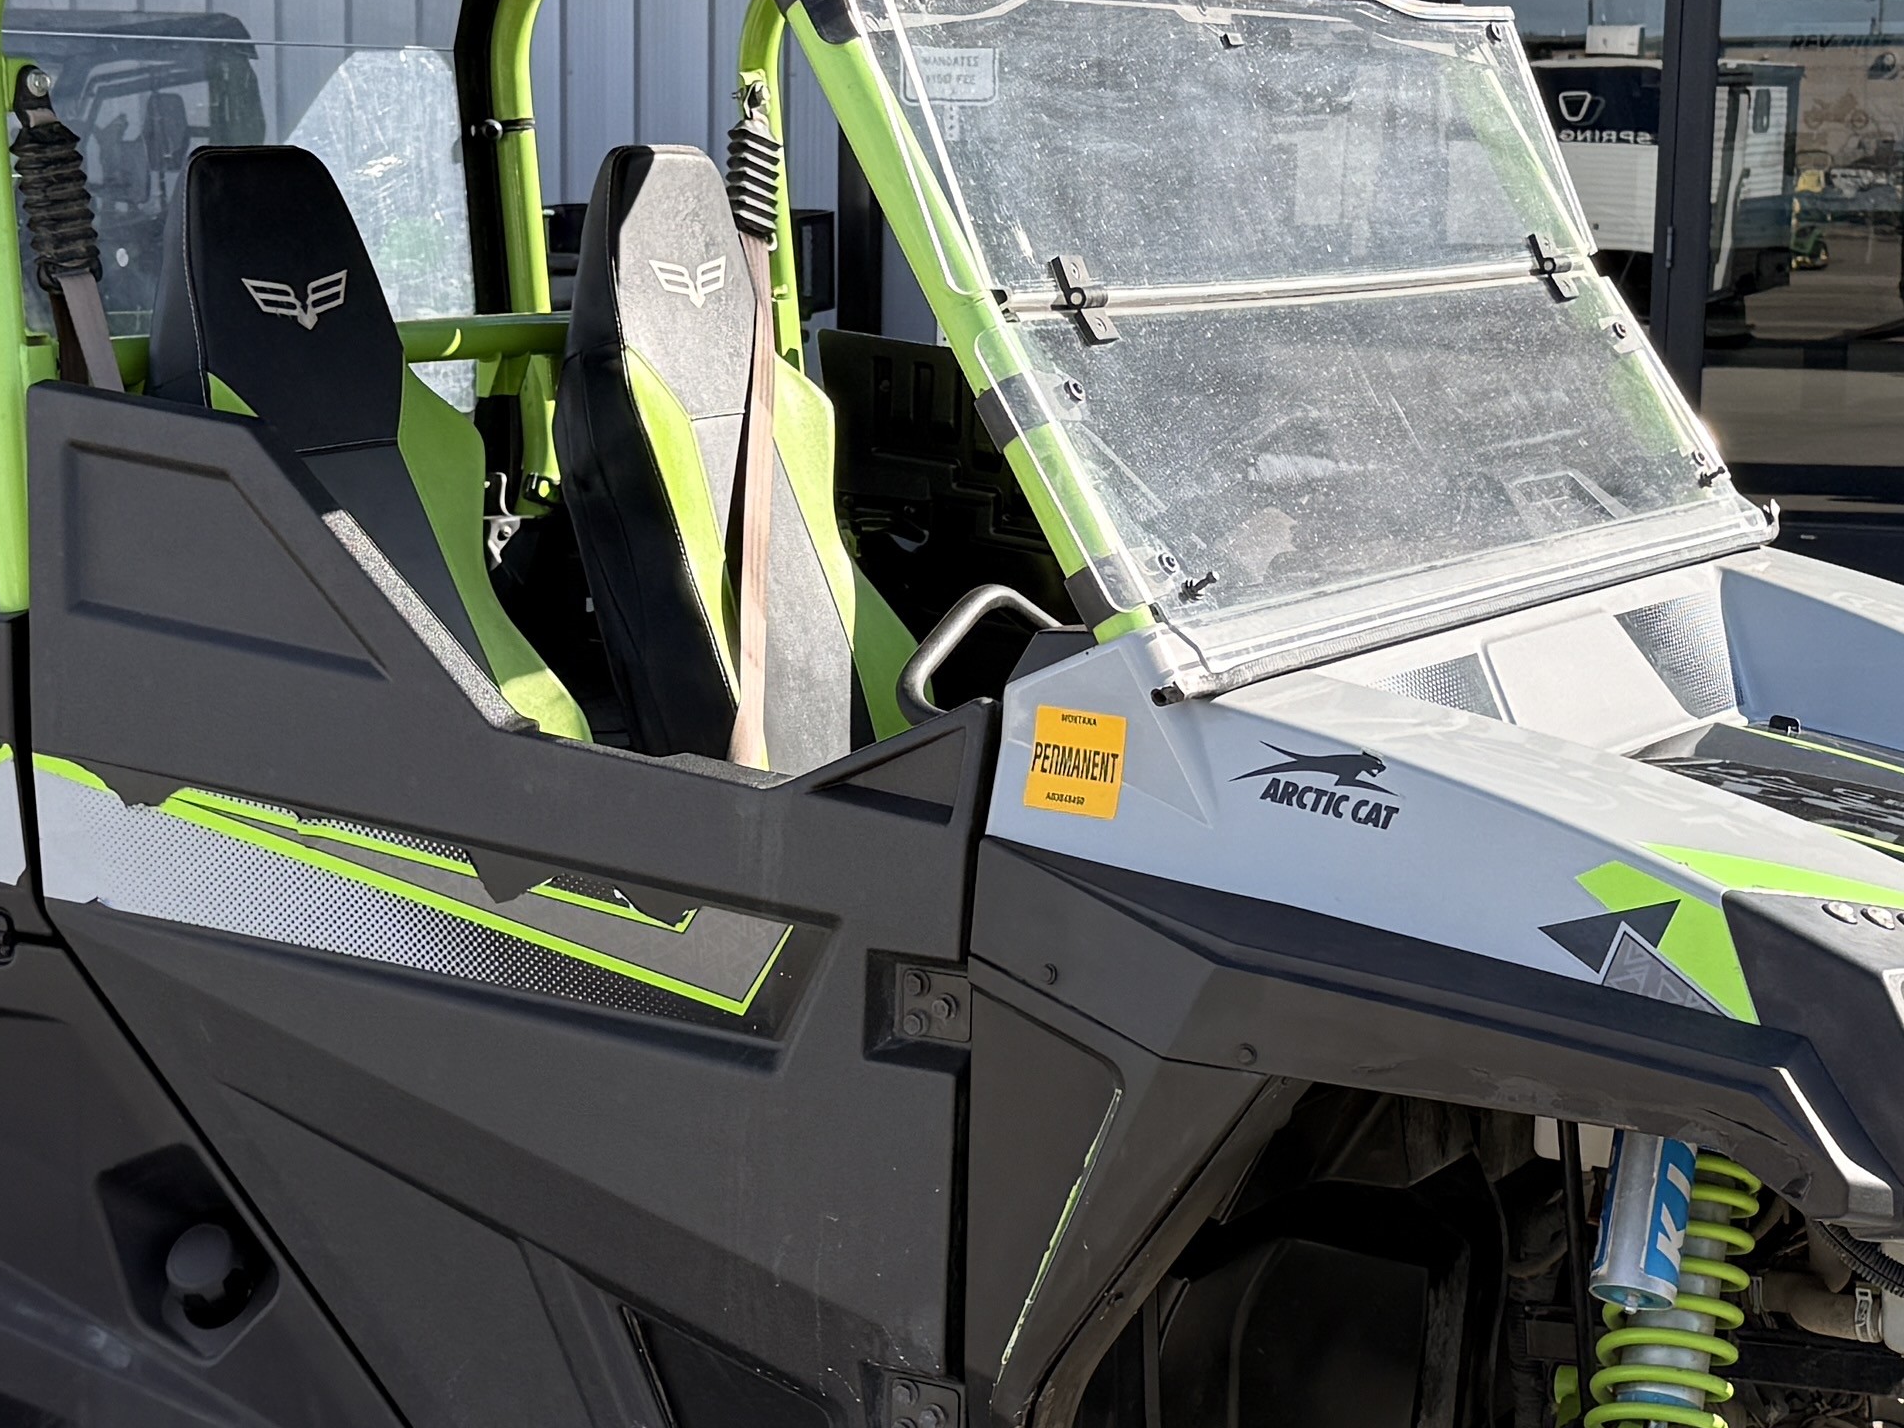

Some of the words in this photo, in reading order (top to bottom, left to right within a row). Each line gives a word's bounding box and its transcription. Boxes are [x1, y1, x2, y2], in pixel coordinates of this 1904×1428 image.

[1031, 742, 1119, 783] PERMANENT
[1260, 777, 1350, 819] ARCTIC
[1351, 805, 1400, 831] CAT
